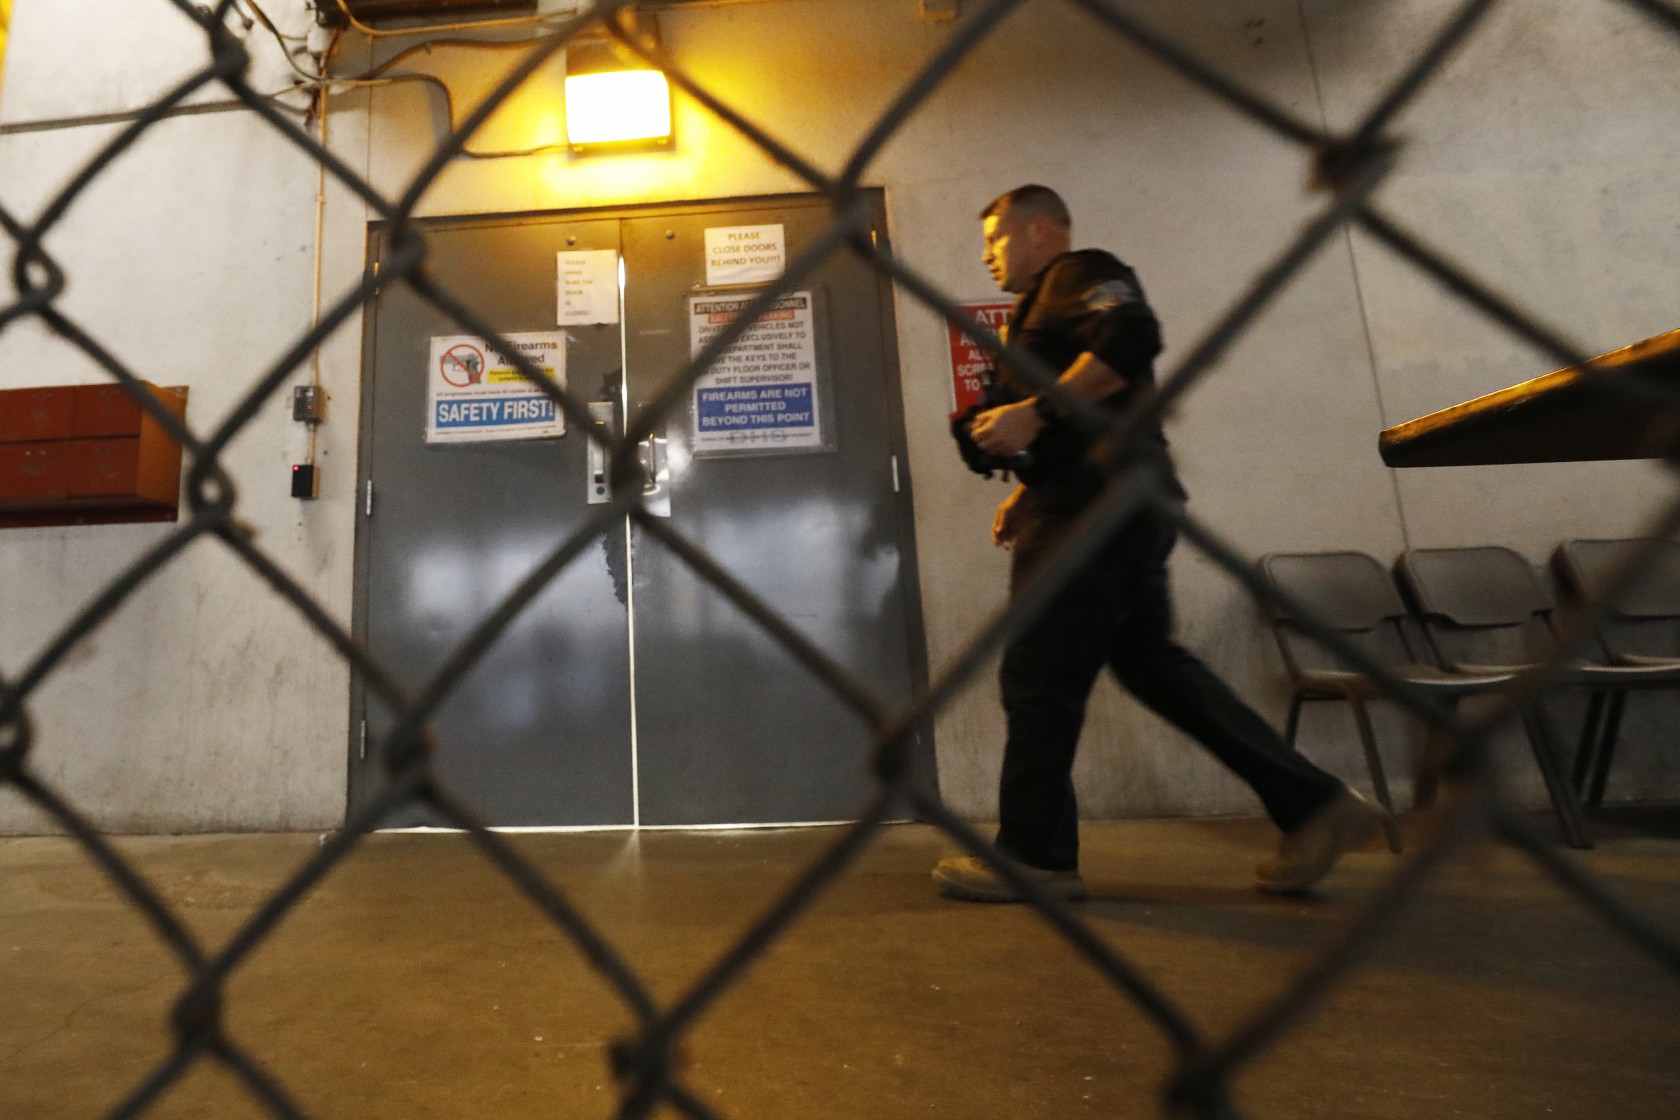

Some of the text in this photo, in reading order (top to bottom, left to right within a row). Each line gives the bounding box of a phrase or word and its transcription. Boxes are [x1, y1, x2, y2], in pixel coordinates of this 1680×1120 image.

[728, 232, 760, 241] PLEASE
[712, 243, 777, 255] CLOSE DOORS
[711, 258, 747, 267] BEHIND
[788, 321, 804, 330] NOT
[741, 333, 793, 343] EXCLUSIVELY
[745, 353, 767, 362] KEYS
[769, 352, 780, 361] TO
[781, 351, 797, 360] THE
[733, 364, 761, 373] FLOOR
[762, 362, 797, 371] OFFICER
[798, 361, 812, 370] OR
[702, 387, 808, 402] FIREARMS ARE NOT
[438, 399, 553, 423] SAFETY FIRST!
[724, 401, 786, 412] PERMITTED
[702, 411, 810, 426] BEYOND THIS POINT
